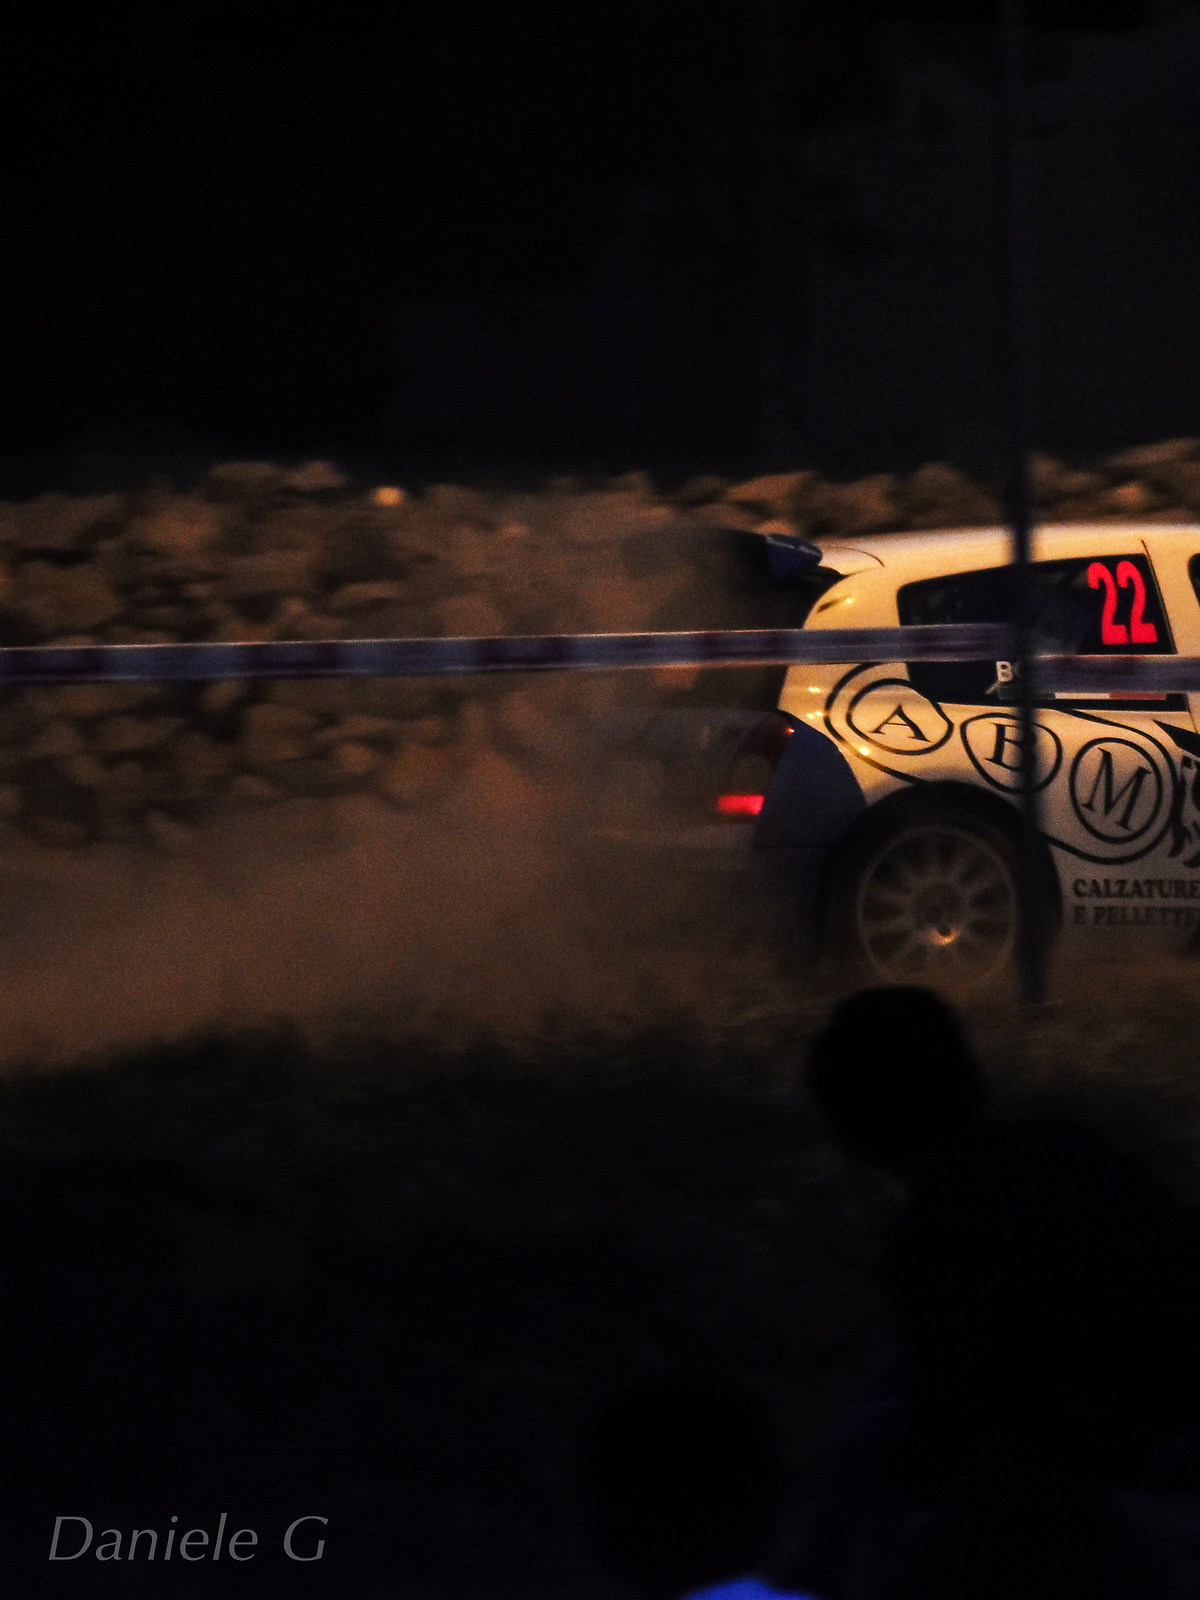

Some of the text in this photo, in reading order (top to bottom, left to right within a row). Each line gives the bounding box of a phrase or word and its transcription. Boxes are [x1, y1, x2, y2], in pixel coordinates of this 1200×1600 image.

[1087, 560, 1157, 645] 22
[1072, 878, 1200, 899] CALZATURE
[1074, 906, 1087, 925] E
